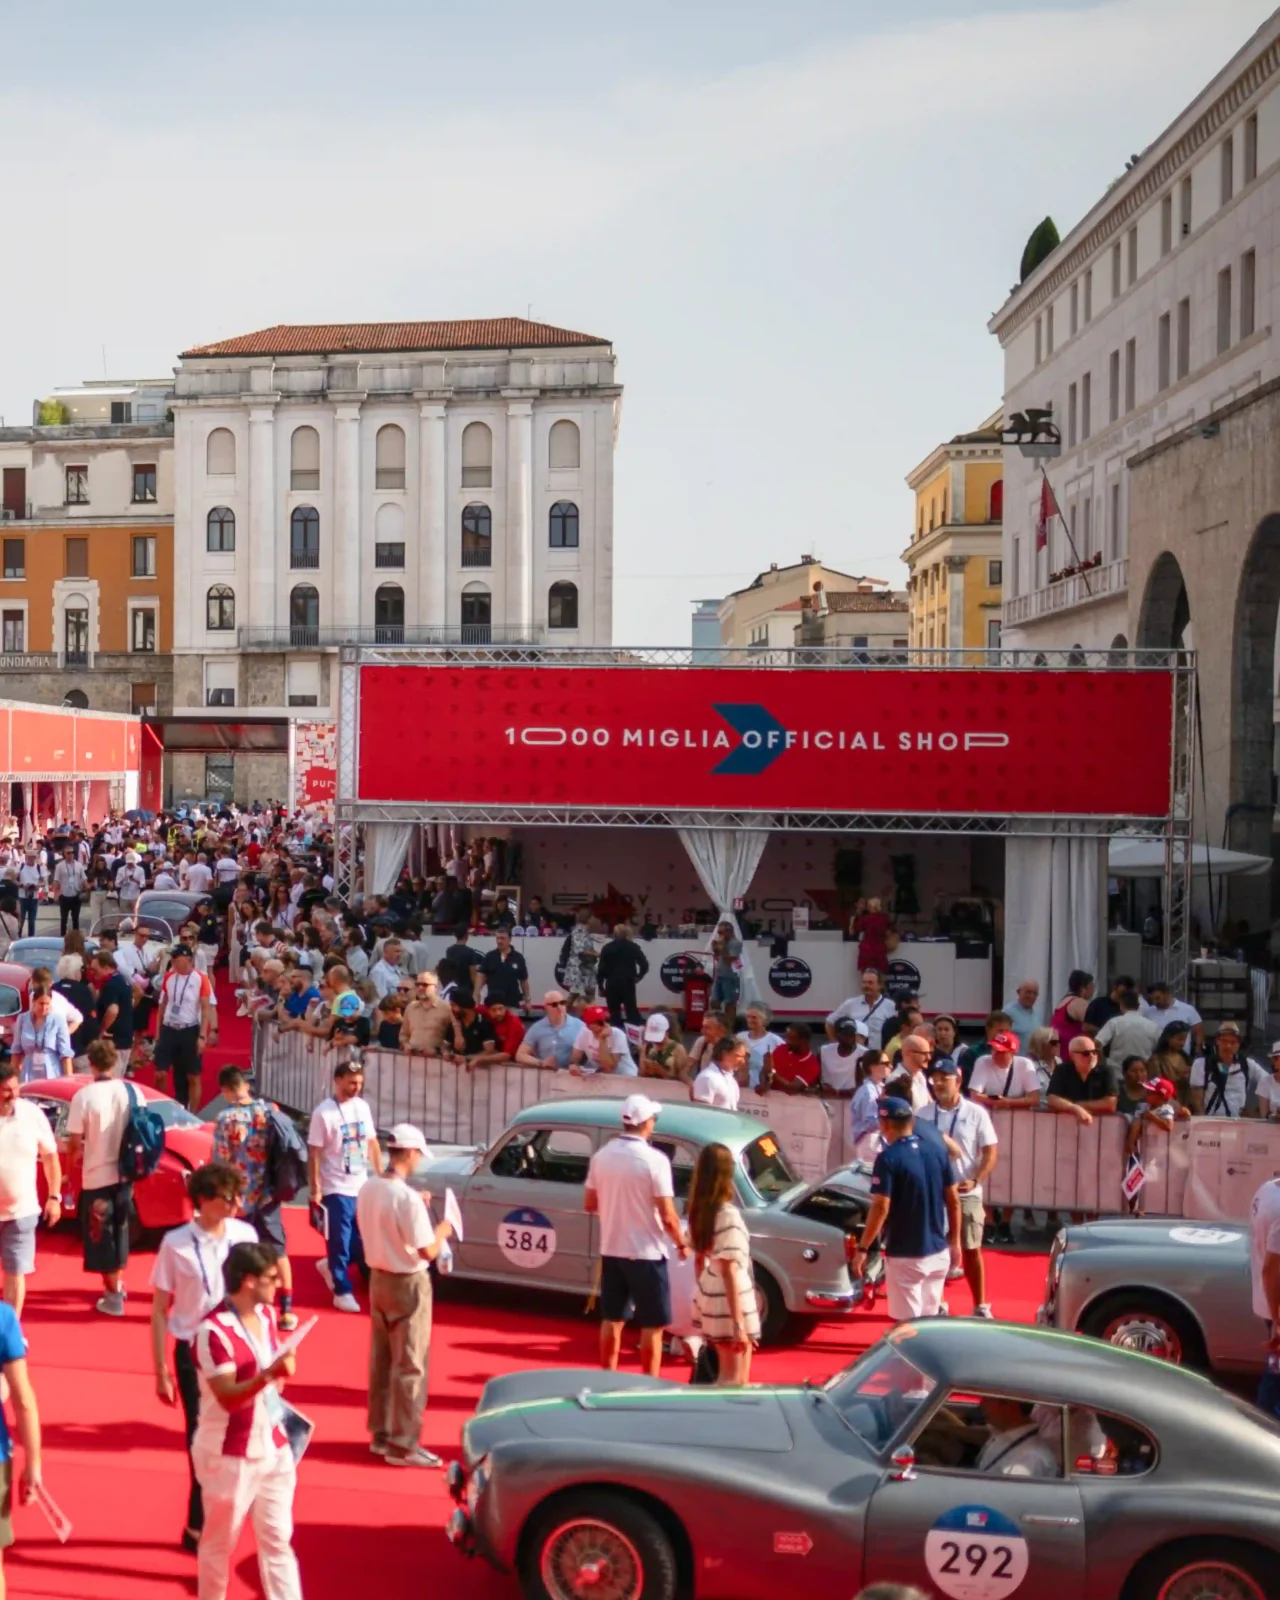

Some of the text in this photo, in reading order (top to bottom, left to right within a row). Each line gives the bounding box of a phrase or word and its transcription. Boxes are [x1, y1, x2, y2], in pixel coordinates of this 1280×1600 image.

[505, 727, 1010, 751] 1000 MIGLIA OFFICIAL SHOP
[780, 979, 801, 987] SHOP
[505, 1229, 548, 1253] 384
[939, 1541, 1013, 1579] 292
